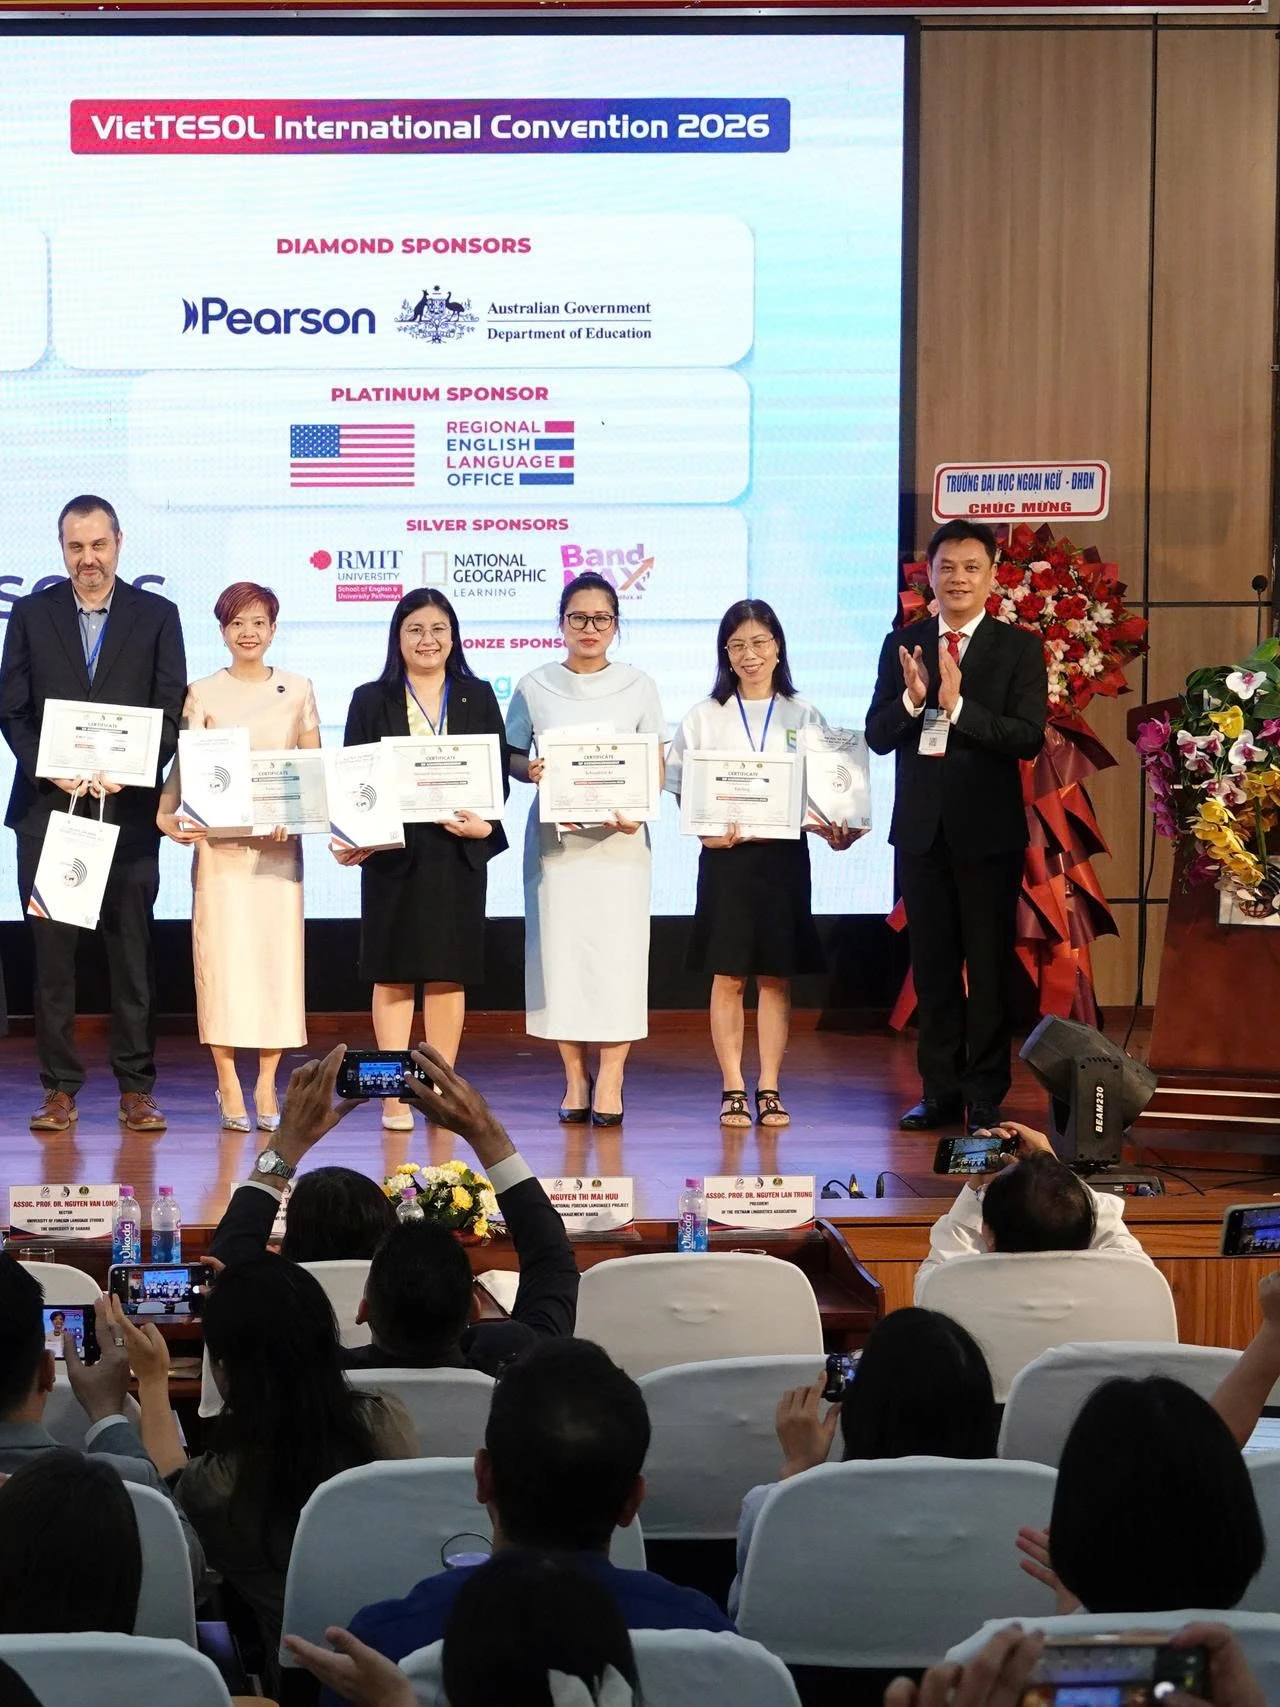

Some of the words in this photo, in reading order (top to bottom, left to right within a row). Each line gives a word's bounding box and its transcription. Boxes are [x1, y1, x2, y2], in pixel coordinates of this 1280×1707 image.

[91, 114, 265, 140] VietTESOL
[275, 114, 481, 140] International
[490, 114, 669, 139] Convention
[677, 113, 770, 139] 2026
[276, 238, 394, 254] DIAMOND
[401, 237, 532, 254] SPONSORS
[487, 301, 561, 315] Australian
[564, 300, 651, 315] Government
[201, 296, 376, 335] Pearson
[487, 326, 567, 343] Department
[569, 326, 583, 340] of
[585, 326, 652, 340] Education
[331, 387, 440, 401] PLATINUM
[446, 386, 550, 401] SPONSOR
[447, 420, 541, 434] REGIONAL
[447, 438, 531, 451] ENGLISH
[446, 455, 555, 468] LANGUAGE
[447, 473, 515, 486] OFFICE
[406, 519, 468, 531] SILVER
[472, 518, 569, 531] SPONSORS
[336, 550, 404, 570] RMIT
[454, 553, 528, 567] NATIONAL
[561, 543, 645, 568] Band
[337, 572, 400, 581] UNIVERSITY
[453, 568, 547, 583] GEOGRAPHIC
[338, 585, 360, 593] School
[369, 585, 393, 594] English
[453, 588, 517, 598] LEARNING
[338, 593, 370, 601] University
[463, 638, 505, 649] ONZE
[1095, 1086, 1104, 1133] BEAM230
[550, 1193, 577, 1201] NGUYEN
[605, 1192, 619, 1200] HUU
[756, 1191, 780, 1199] NGUYEN
